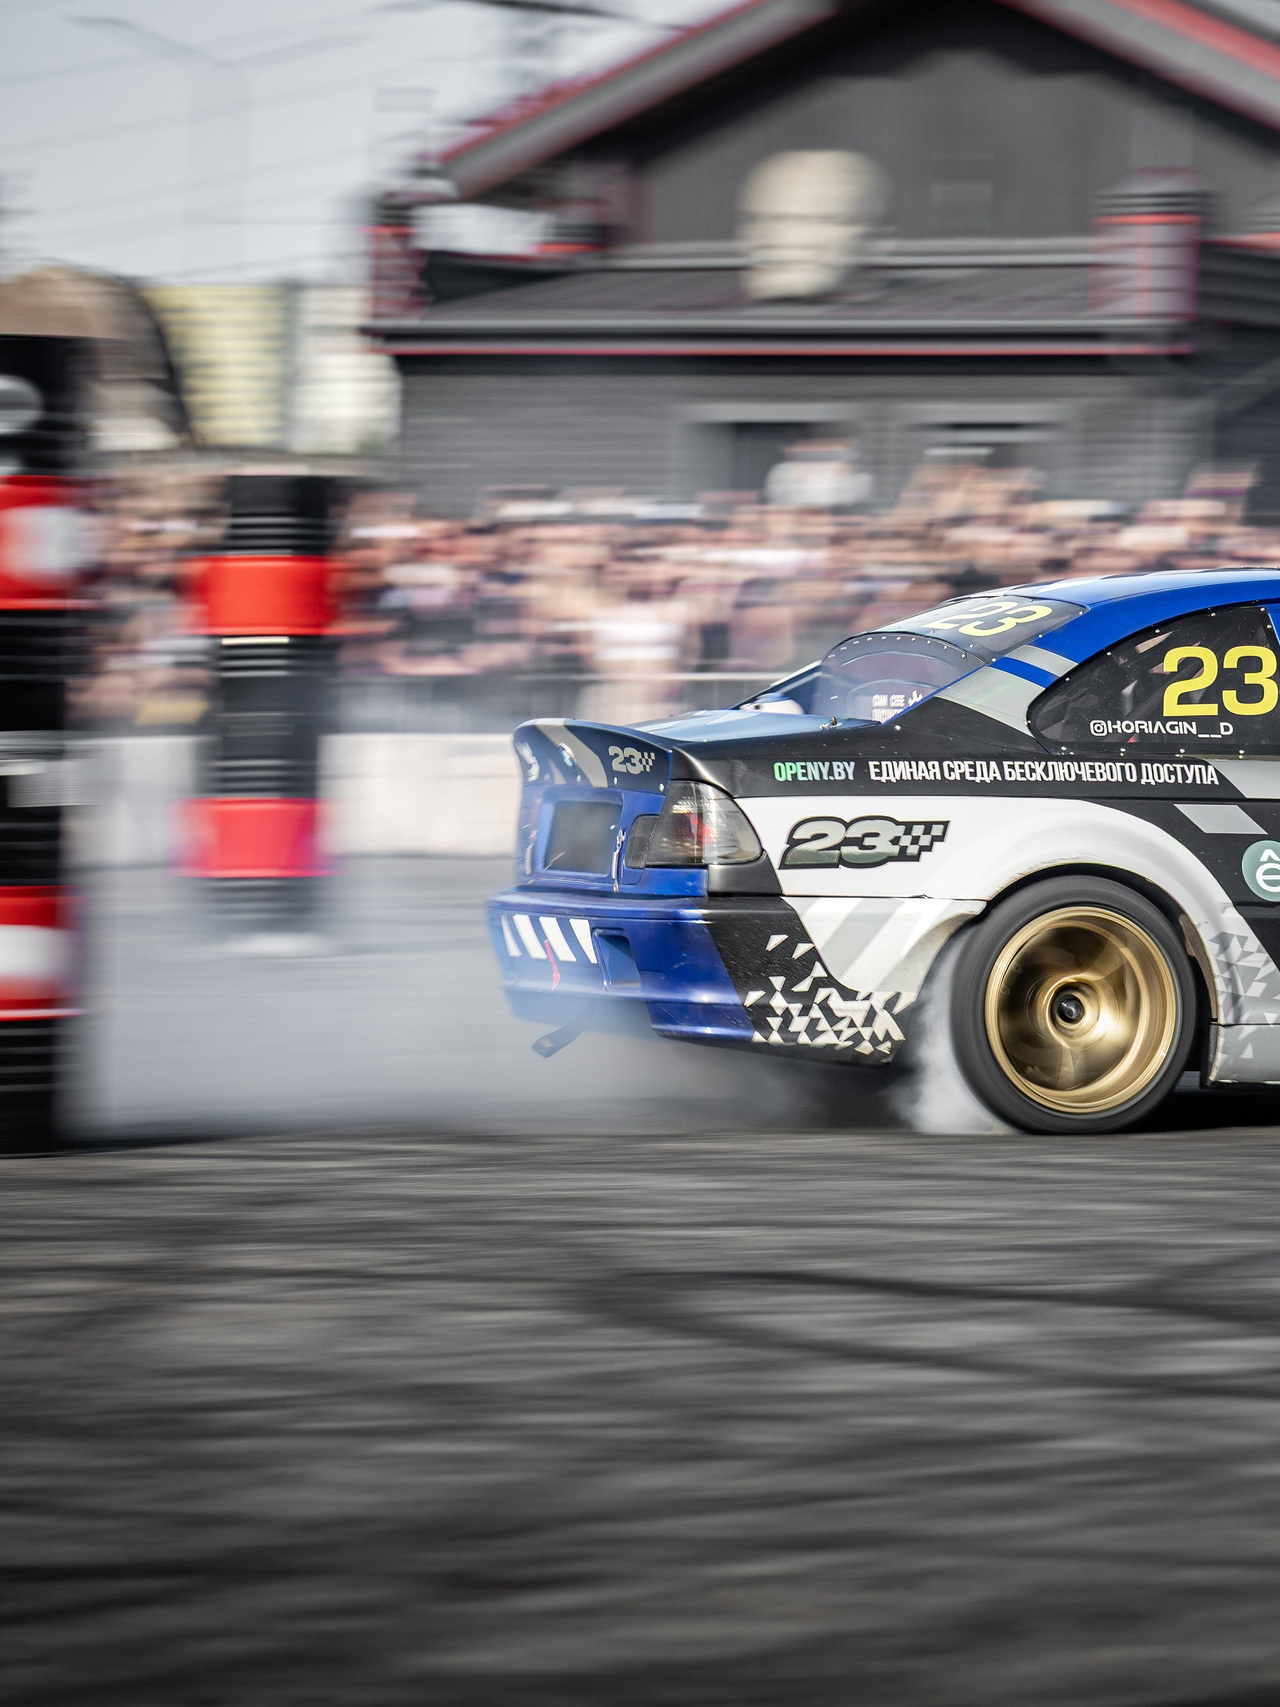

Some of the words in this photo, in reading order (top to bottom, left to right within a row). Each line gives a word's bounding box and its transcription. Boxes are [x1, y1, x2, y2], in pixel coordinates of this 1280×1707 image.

[920, 601, 1053, 637] 23
[1163, 646, 1279, 716] 23
[608, 745, 643, 775] 23
[773, 761, 855, 782] OPENY.BY
[868, 761, 941, 783] ЕДИНАЯ
[942, 761, 1002, 783] СРЕДА
[1003, 761, 1137, 783] БЕСКЛЮЧЕВОГО
[1140, 763, 1219, 785] ДОСТУПА
[784, 819, 901, 864] 23
